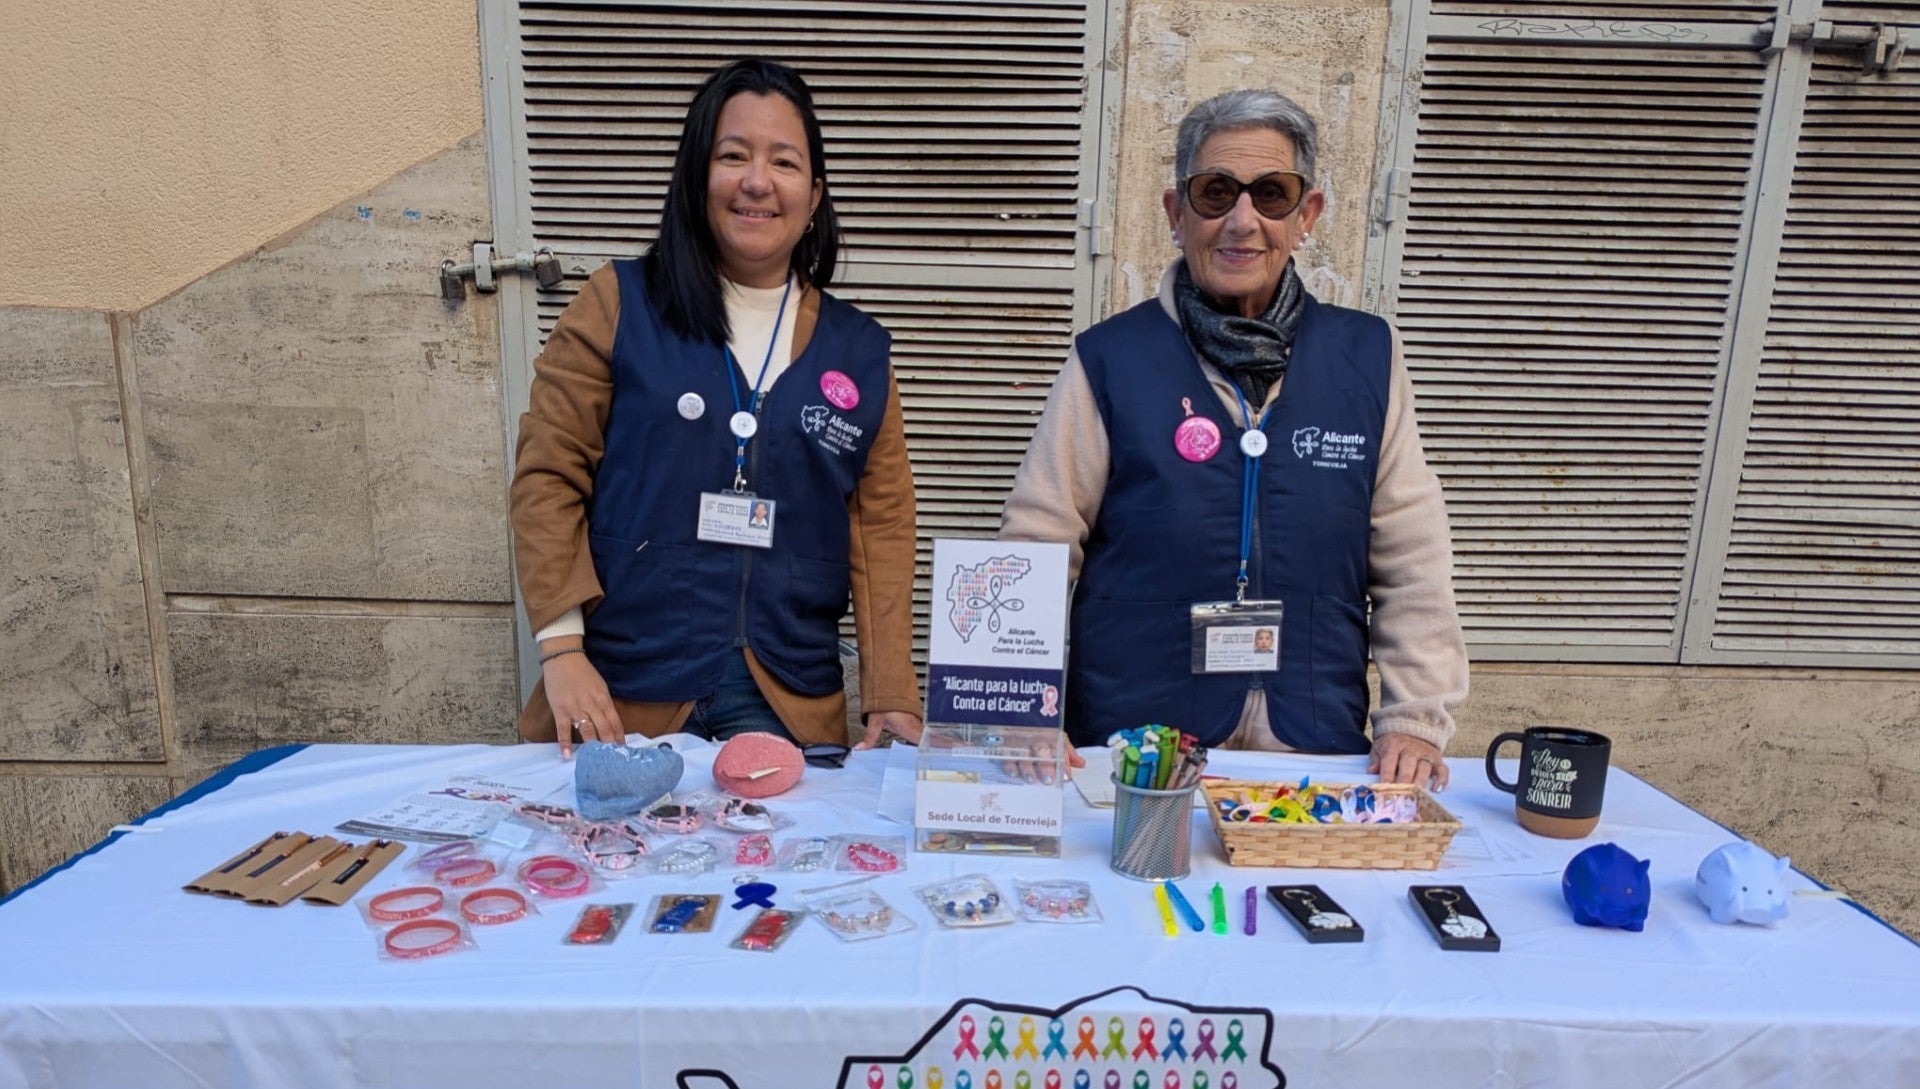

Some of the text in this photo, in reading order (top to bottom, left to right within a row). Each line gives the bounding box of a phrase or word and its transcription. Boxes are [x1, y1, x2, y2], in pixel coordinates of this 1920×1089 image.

[829, 414, 863, 437] Alicante
[1322, 431, 1365, 444] Alicante
[1008, 628, 1036, 636] Alicante
[998, 636, 1045, 646] Para la Lucha
[991, 646, 1015, 654] Contra
[985, 680, 1008, 694] para
[1009, 679, 1018, 693] la
[1020, 679, 1048, 694] Lucha
[953, 695, 986, 710] Contra
[987, 697, 997, 711] el
[928, 811, 1058, 828] Sede Local de Torrevieja
